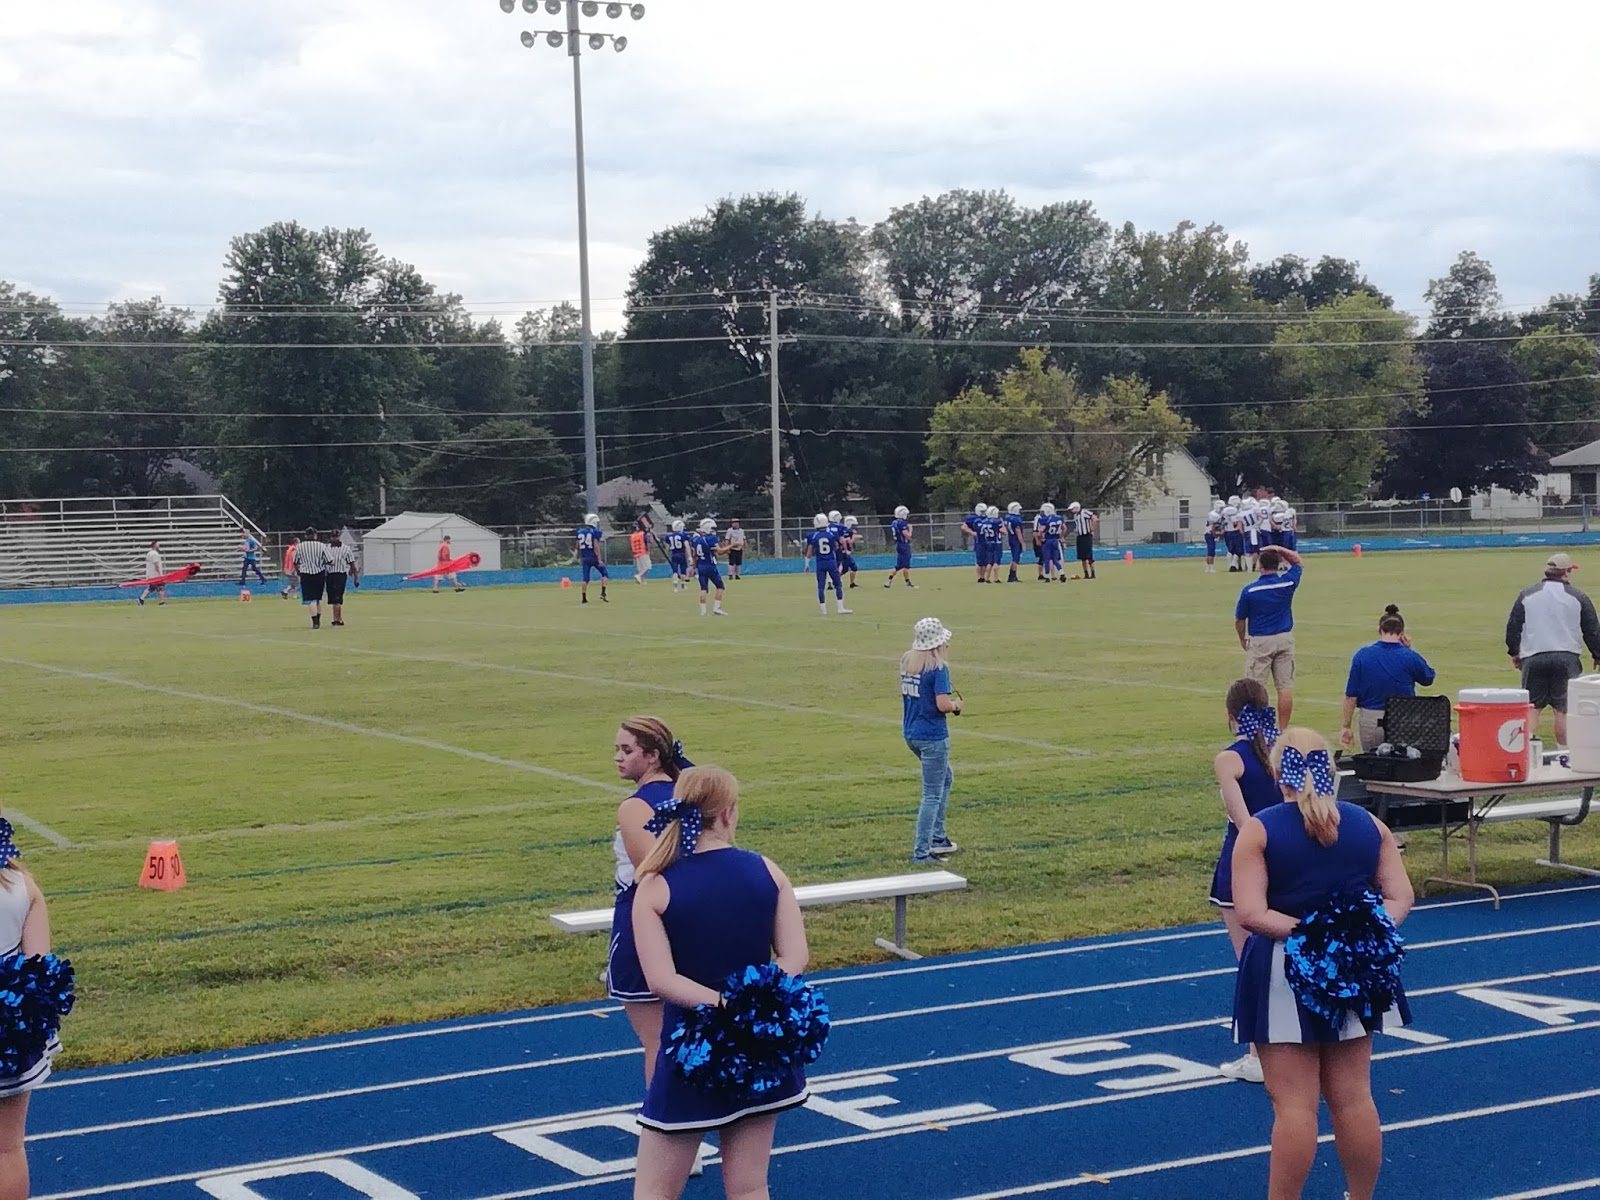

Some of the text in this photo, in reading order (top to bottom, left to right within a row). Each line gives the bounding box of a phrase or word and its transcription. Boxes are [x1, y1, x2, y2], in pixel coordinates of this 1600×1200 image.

[1243, 513, 1256, 527] 11
[577, 533, 593, 549] 24
[668, 534, 682, 550] 16
[818, 537, 831, 555] 6
[149, 856, 165, 880] 50
